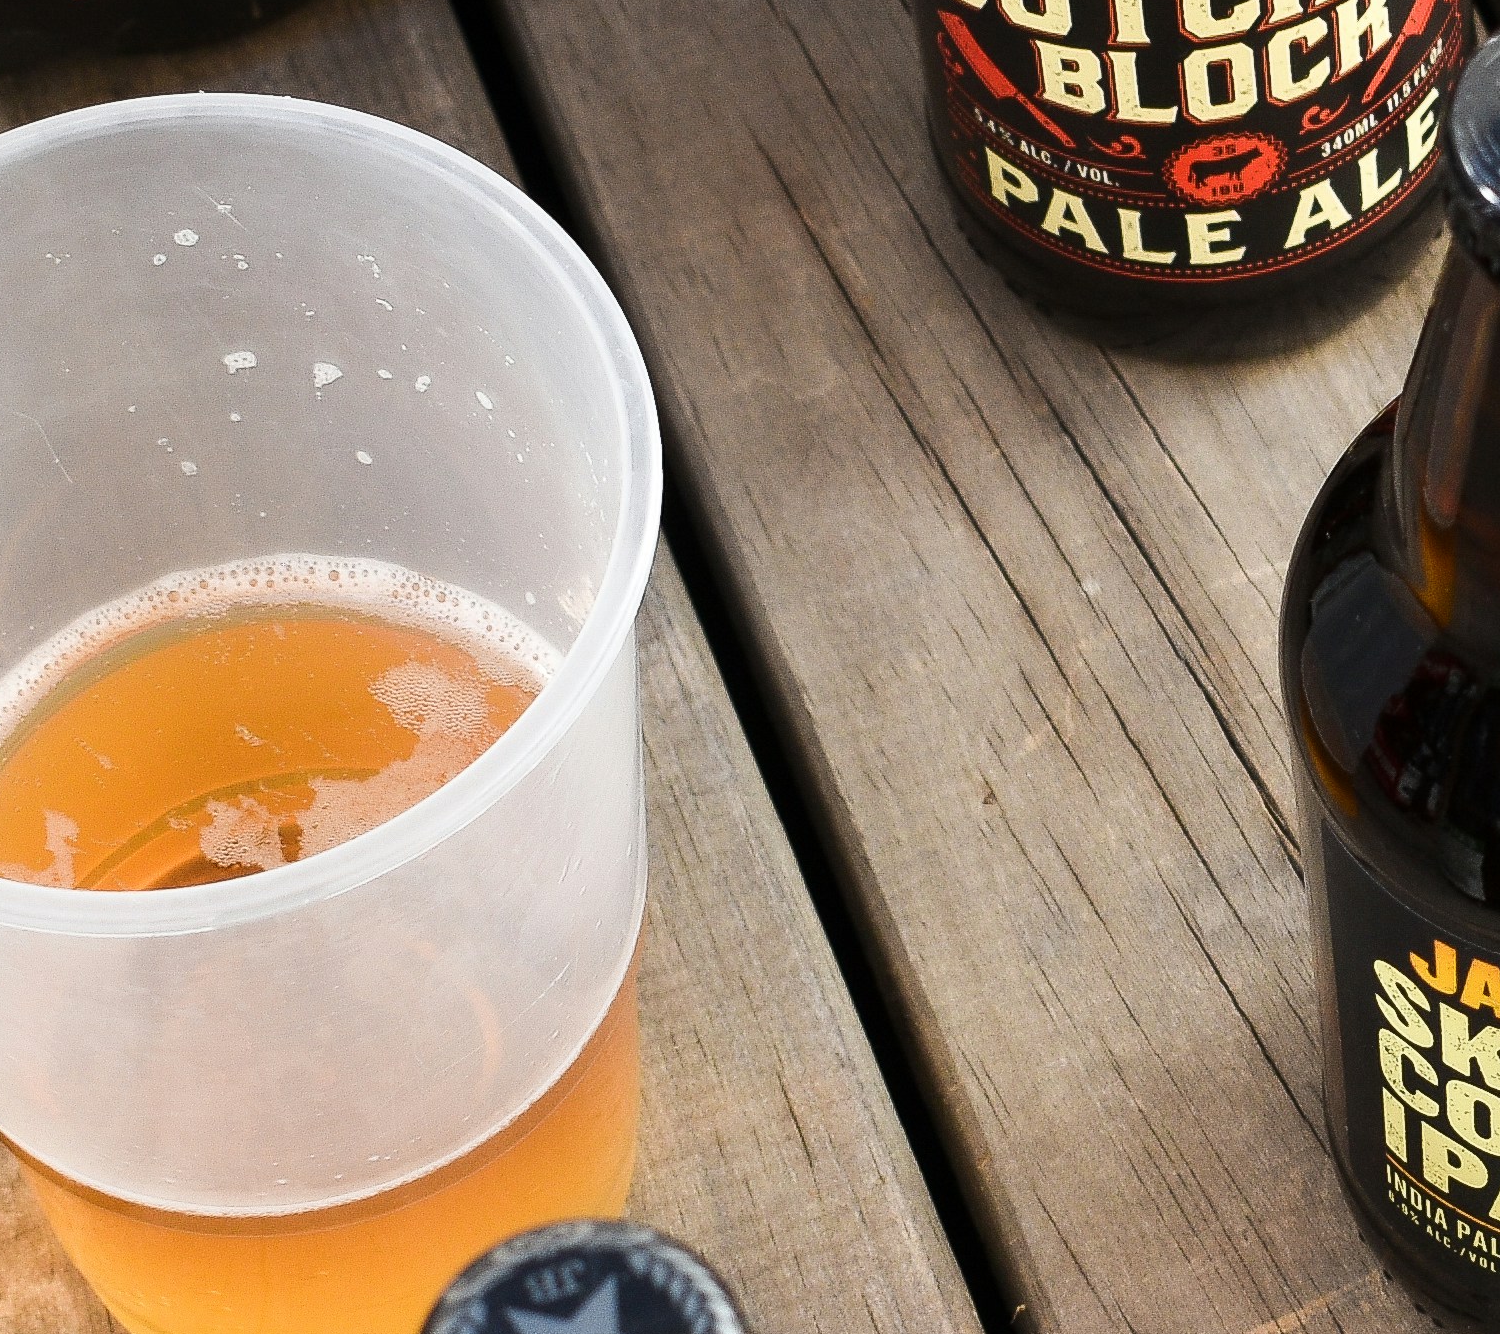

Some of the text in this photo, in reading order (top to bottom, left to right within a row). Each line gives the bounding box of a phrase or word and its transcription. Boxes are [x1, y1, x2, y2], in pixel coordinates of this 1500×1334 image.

[983, 86, 1441, 266] PALE ALE
[1076, 162, 1120, 187] VOL.
[1320, 112, 1380, 158] 340ML
[1386, 1163, 1449, 1231] INDIA
